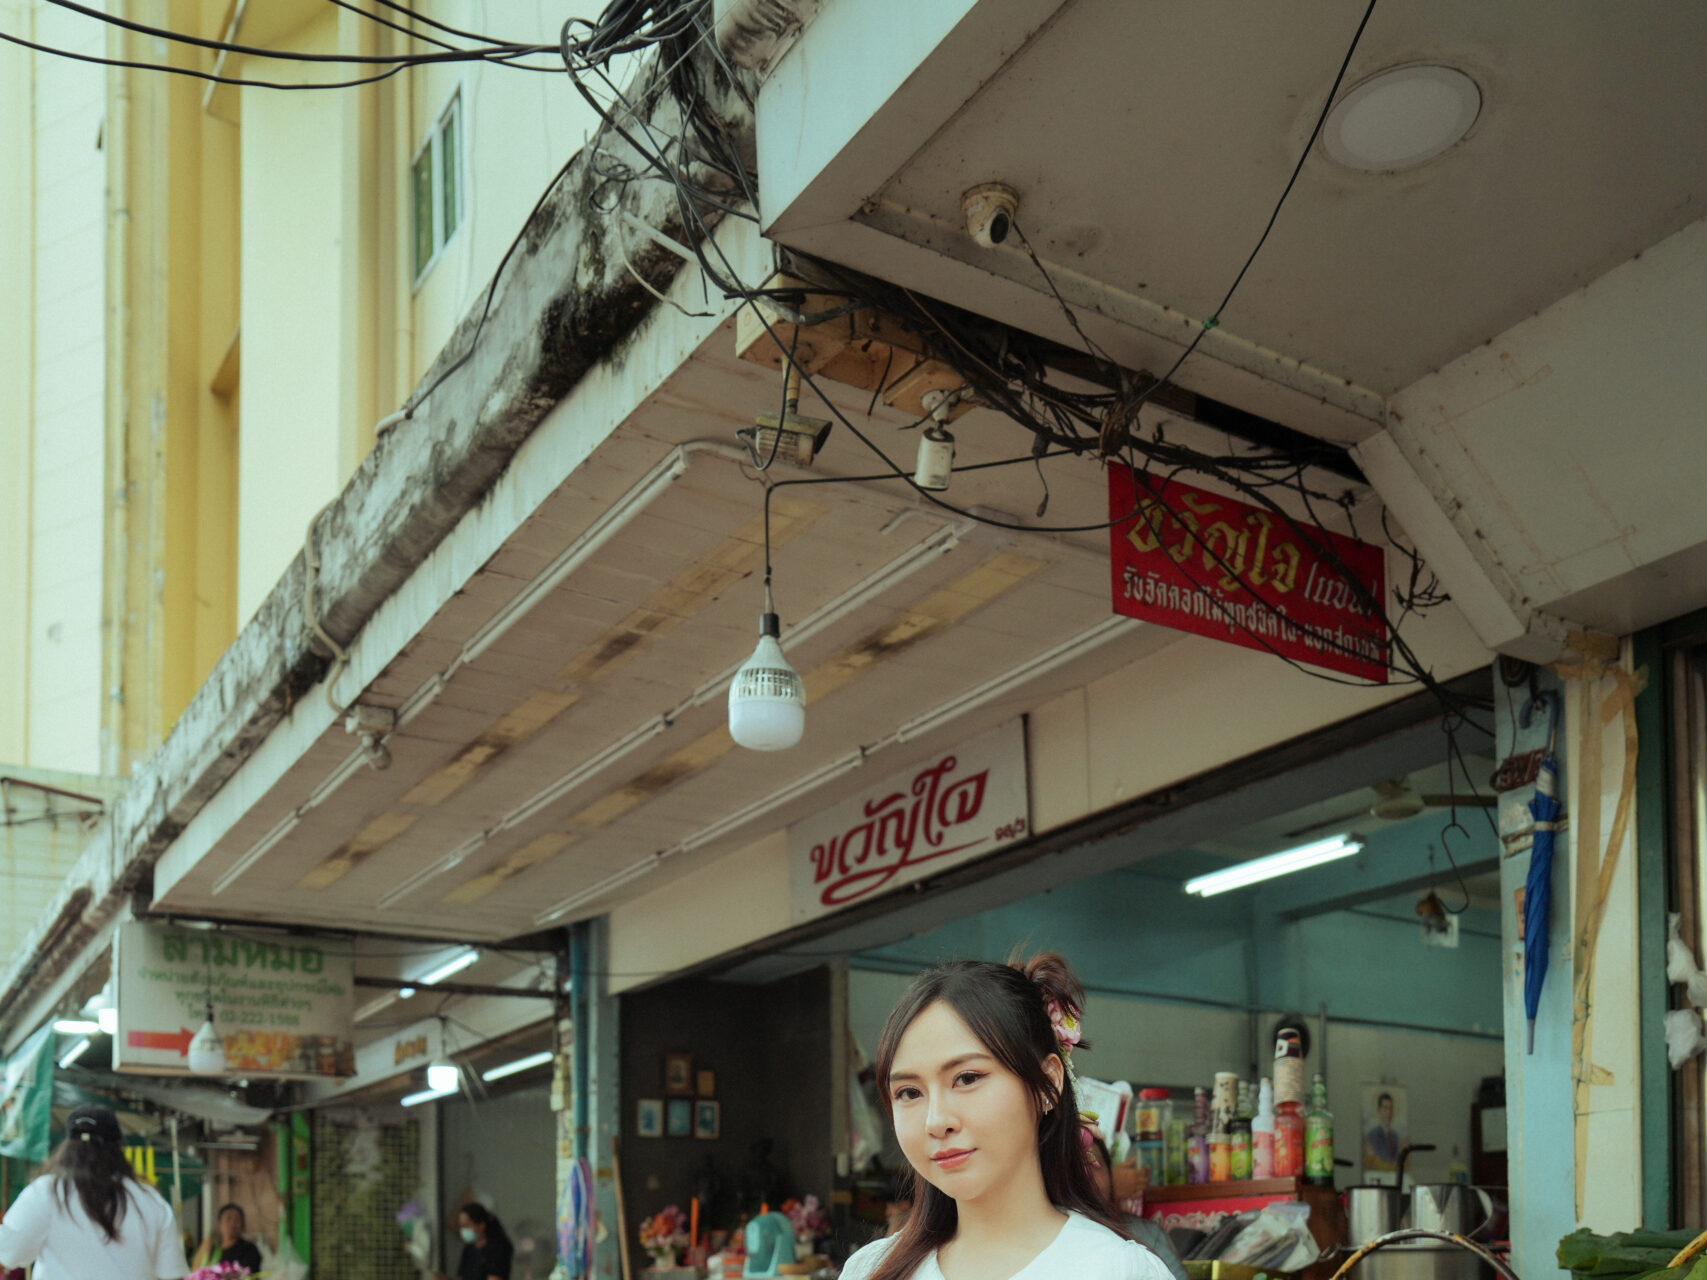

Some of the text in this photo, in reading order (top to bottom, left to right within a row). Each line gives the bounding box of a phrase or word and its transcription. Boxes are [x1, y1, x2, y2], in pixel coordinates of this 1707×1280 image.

[1126, 490, 1301, 593] ขวัญใจ
[810, 755, 989, 906] ขวัญใจ
[161, 932, 325, 974] สามหมอ
